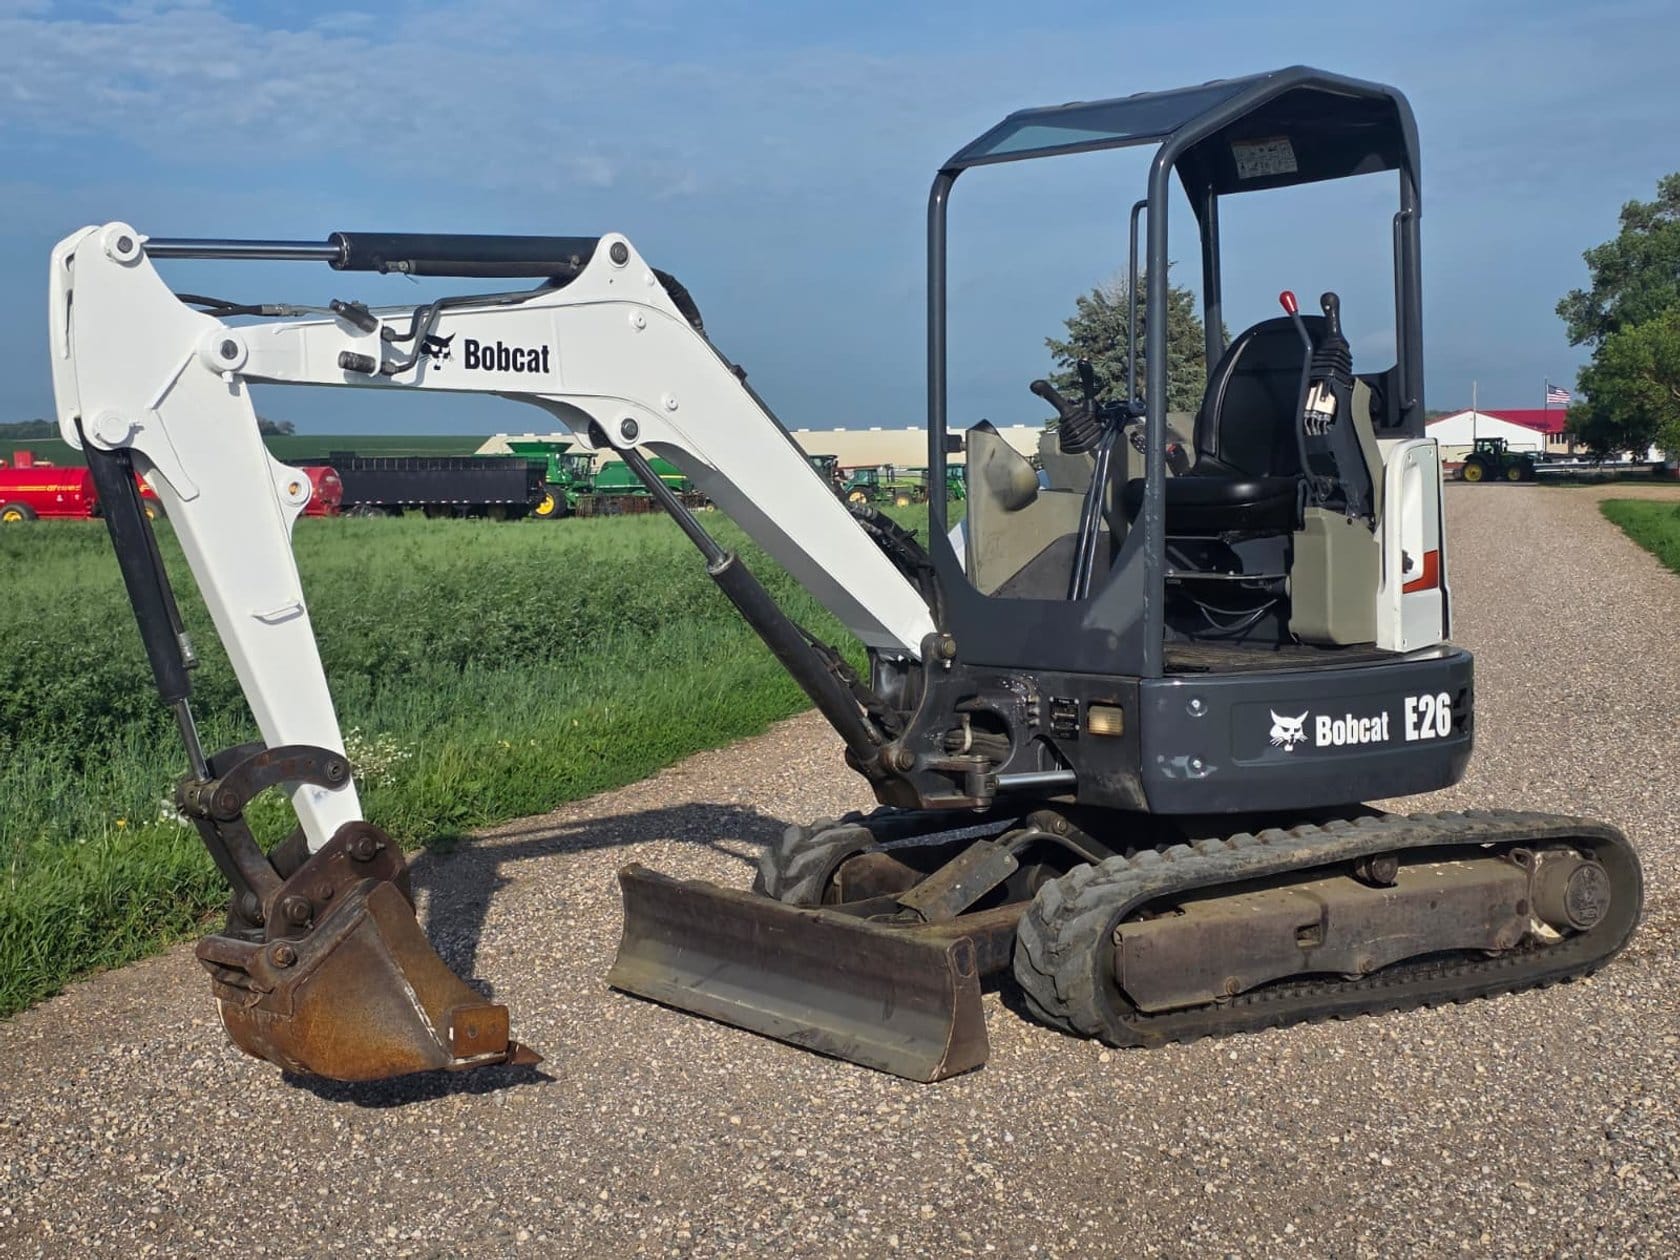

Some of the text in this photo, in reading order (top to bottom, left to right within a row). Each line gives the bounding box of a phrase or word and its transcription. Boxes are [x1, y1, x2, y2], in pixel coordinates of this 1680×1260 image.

[464, 339, 550, 373] Bobcat
[1315, 692, 1452, 747] Bobcat E26
